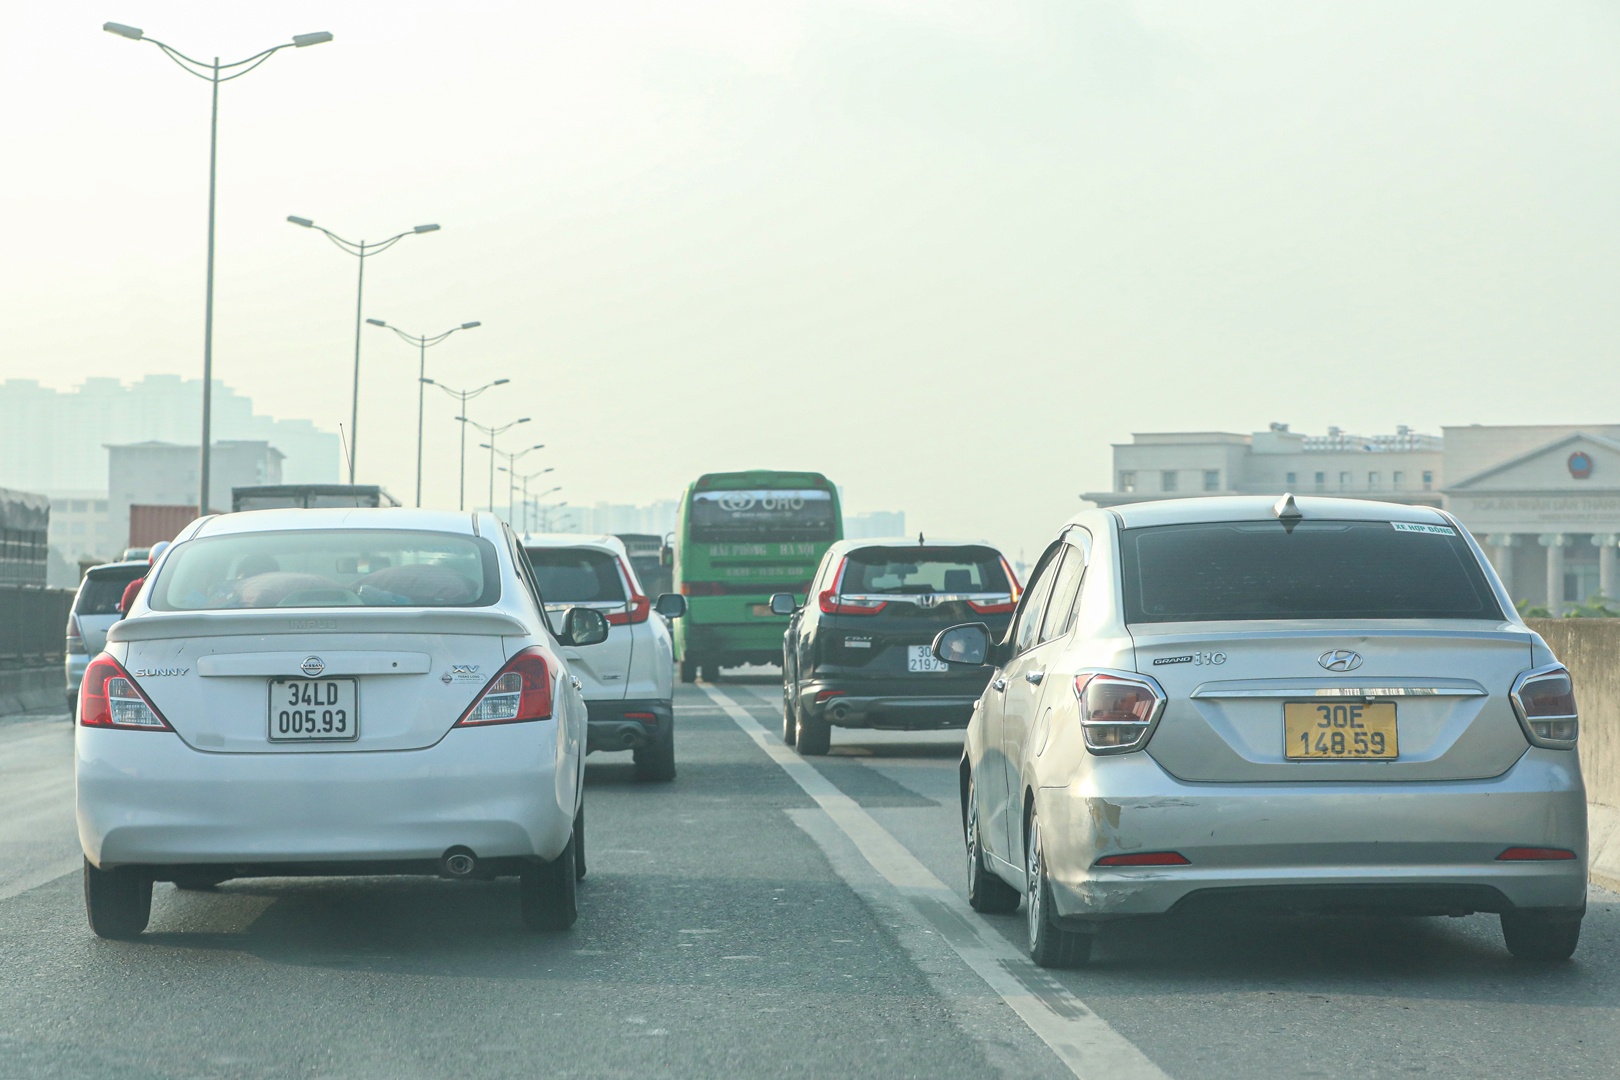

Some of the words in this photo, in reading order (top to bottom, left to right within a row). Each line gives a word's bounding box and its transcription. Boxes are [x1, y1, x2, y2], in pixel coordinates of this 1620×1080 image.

[1395, 523, 1407, 531] XE
[1408, 524, 1425, 532] HỢP
[289, 620, 337, 630] IMPUL
[918, 646, 932, 658] 30
[1154, 656, 1191, 665] GRAND
[1194, 651, 1227, 666] i10
[452, 665, 480, 673] XV
[910, 659, 948, 671] 219.75
[135, 668, 190, 678] SUNNY
[288, 682, 338, 706] 34LD
[279, 709, 346, 733] 005.93
[1317, 705, 1364, 728] 30E
[1301, 731, 1385, 755] 148.59
